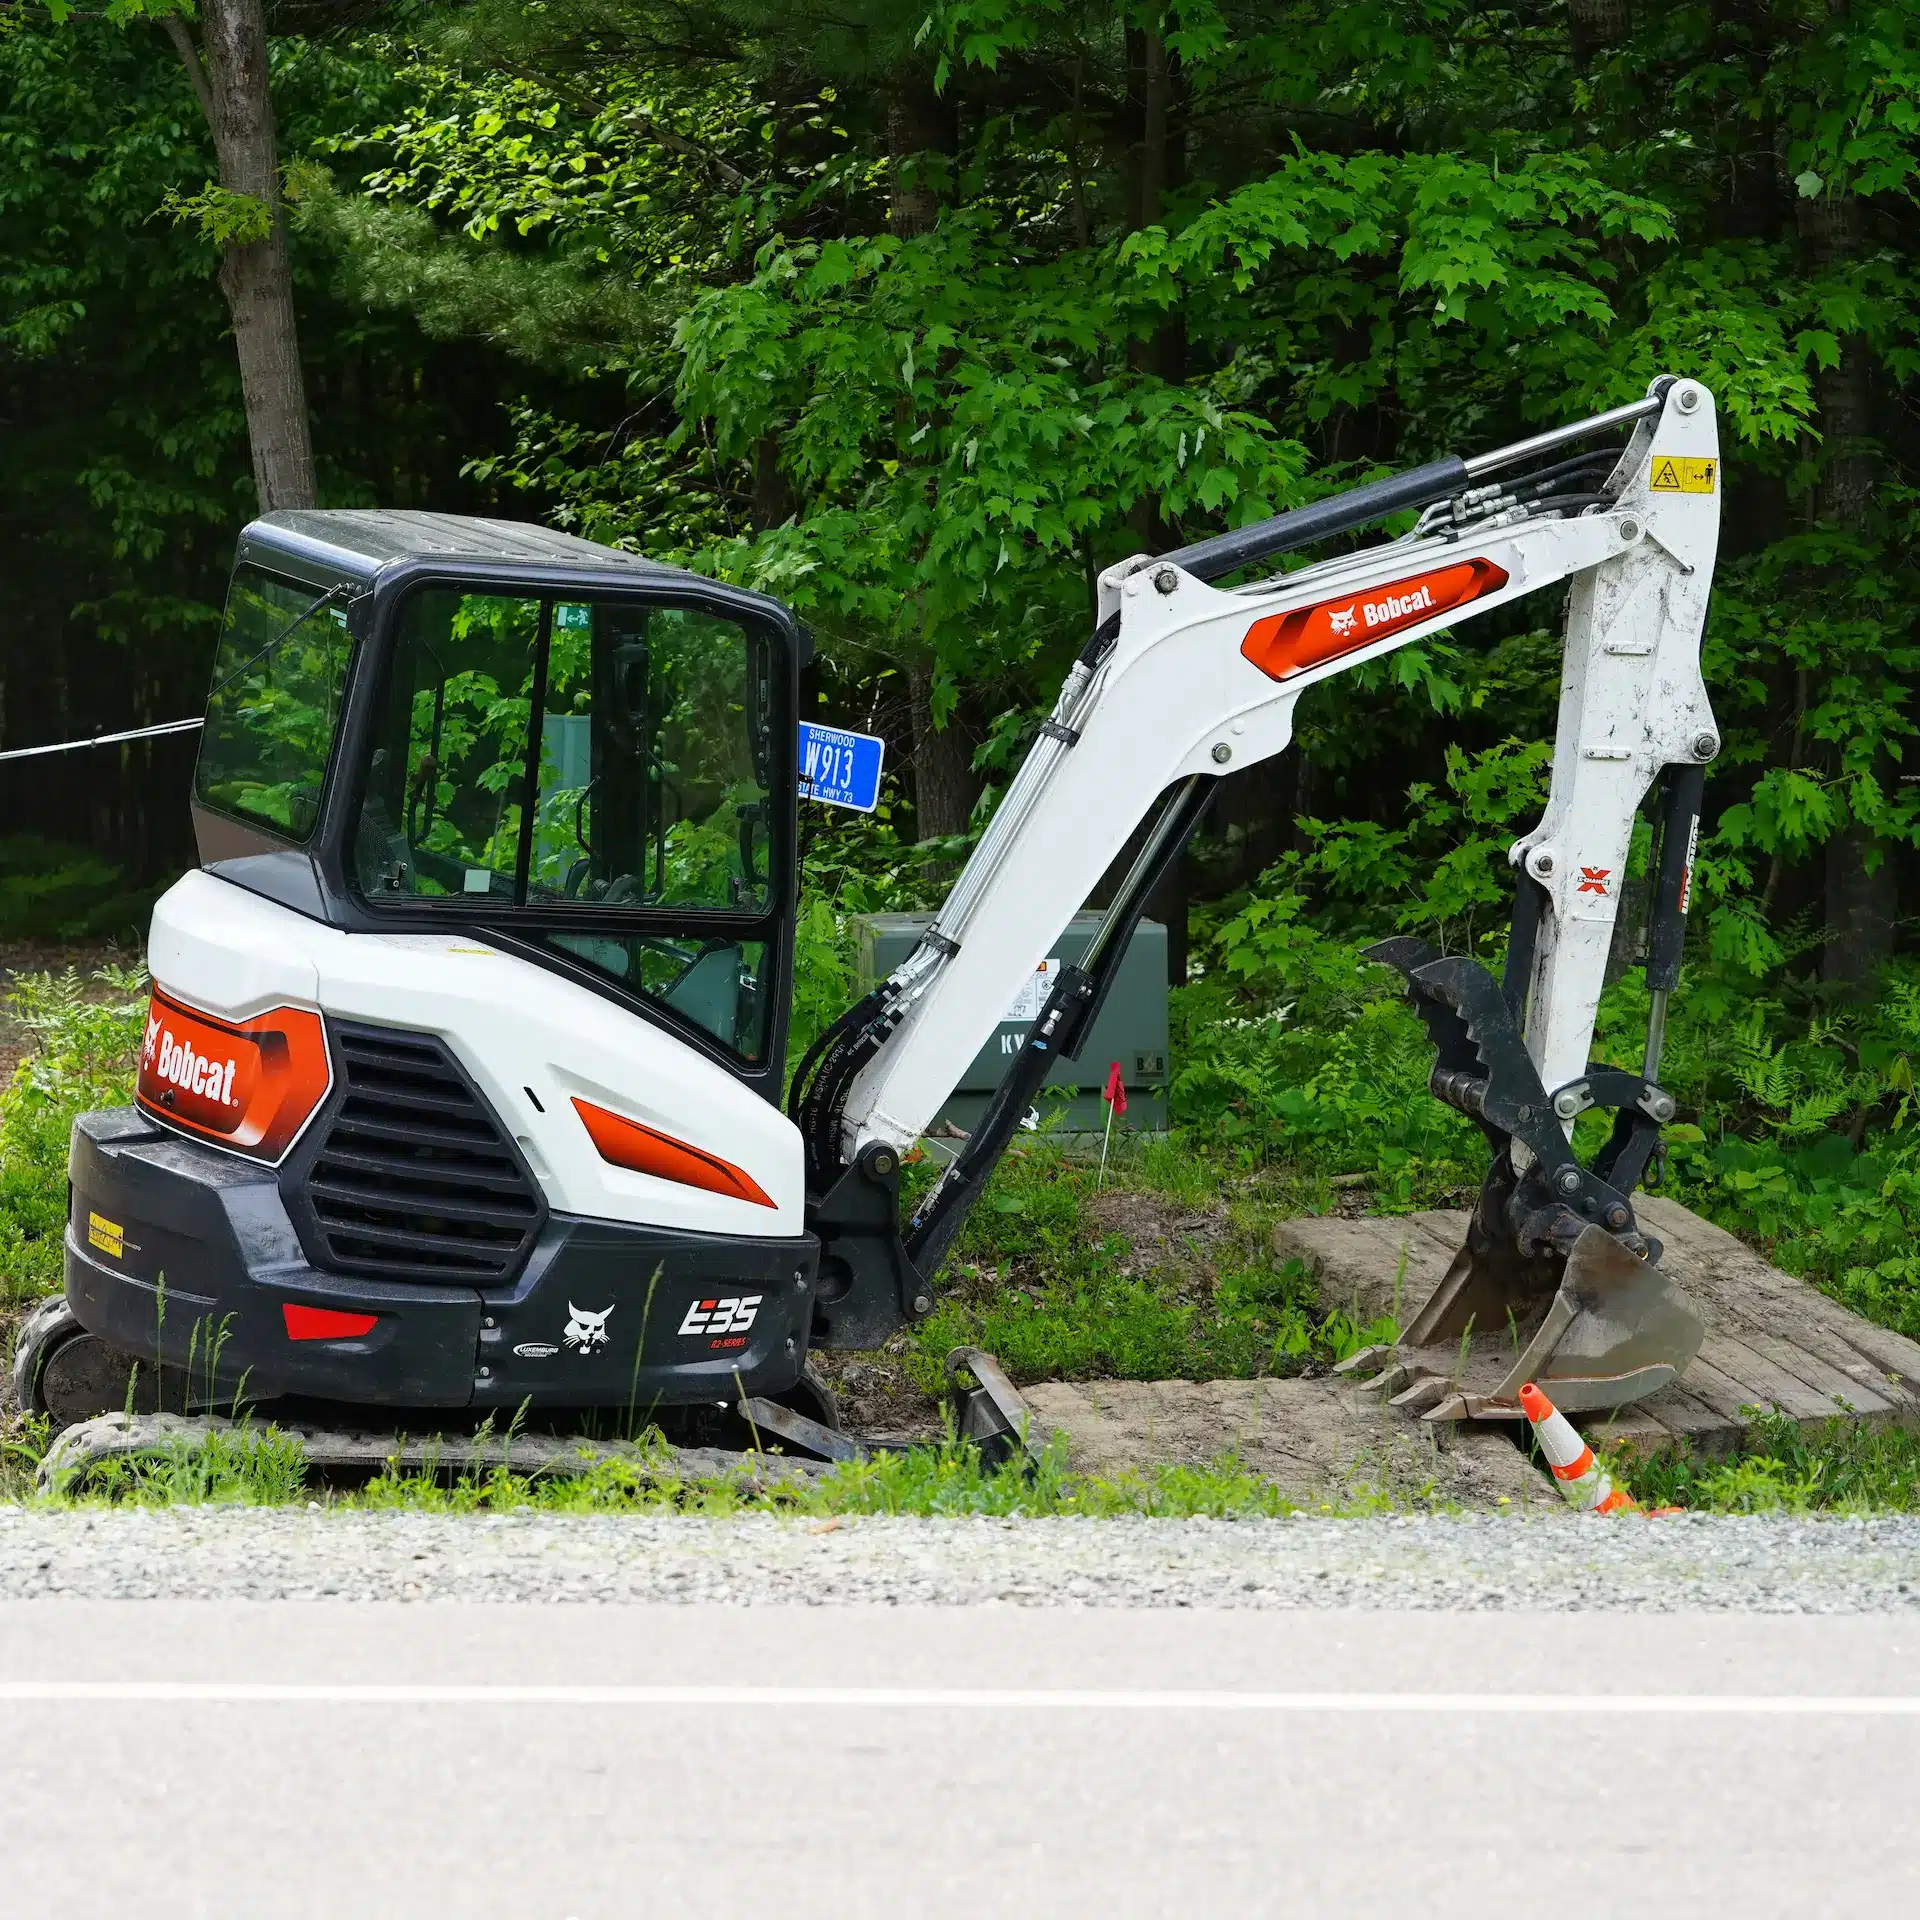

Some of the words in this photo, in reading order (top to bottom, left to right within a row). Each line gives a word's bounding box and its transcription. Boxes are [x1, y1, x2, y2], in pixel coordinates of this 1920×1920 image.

[1362, 585, 1432, 628] Bobcat
[809, 728, 856, 748] SHERWOOD
[805, 740, 854, 789] W913
[822, 786, 842, 800] HWY
[843, 791, 854, 803] 73
[157, 1029, 236, 1106] Bobcat
[677, 1294, 763, 1335] E35
